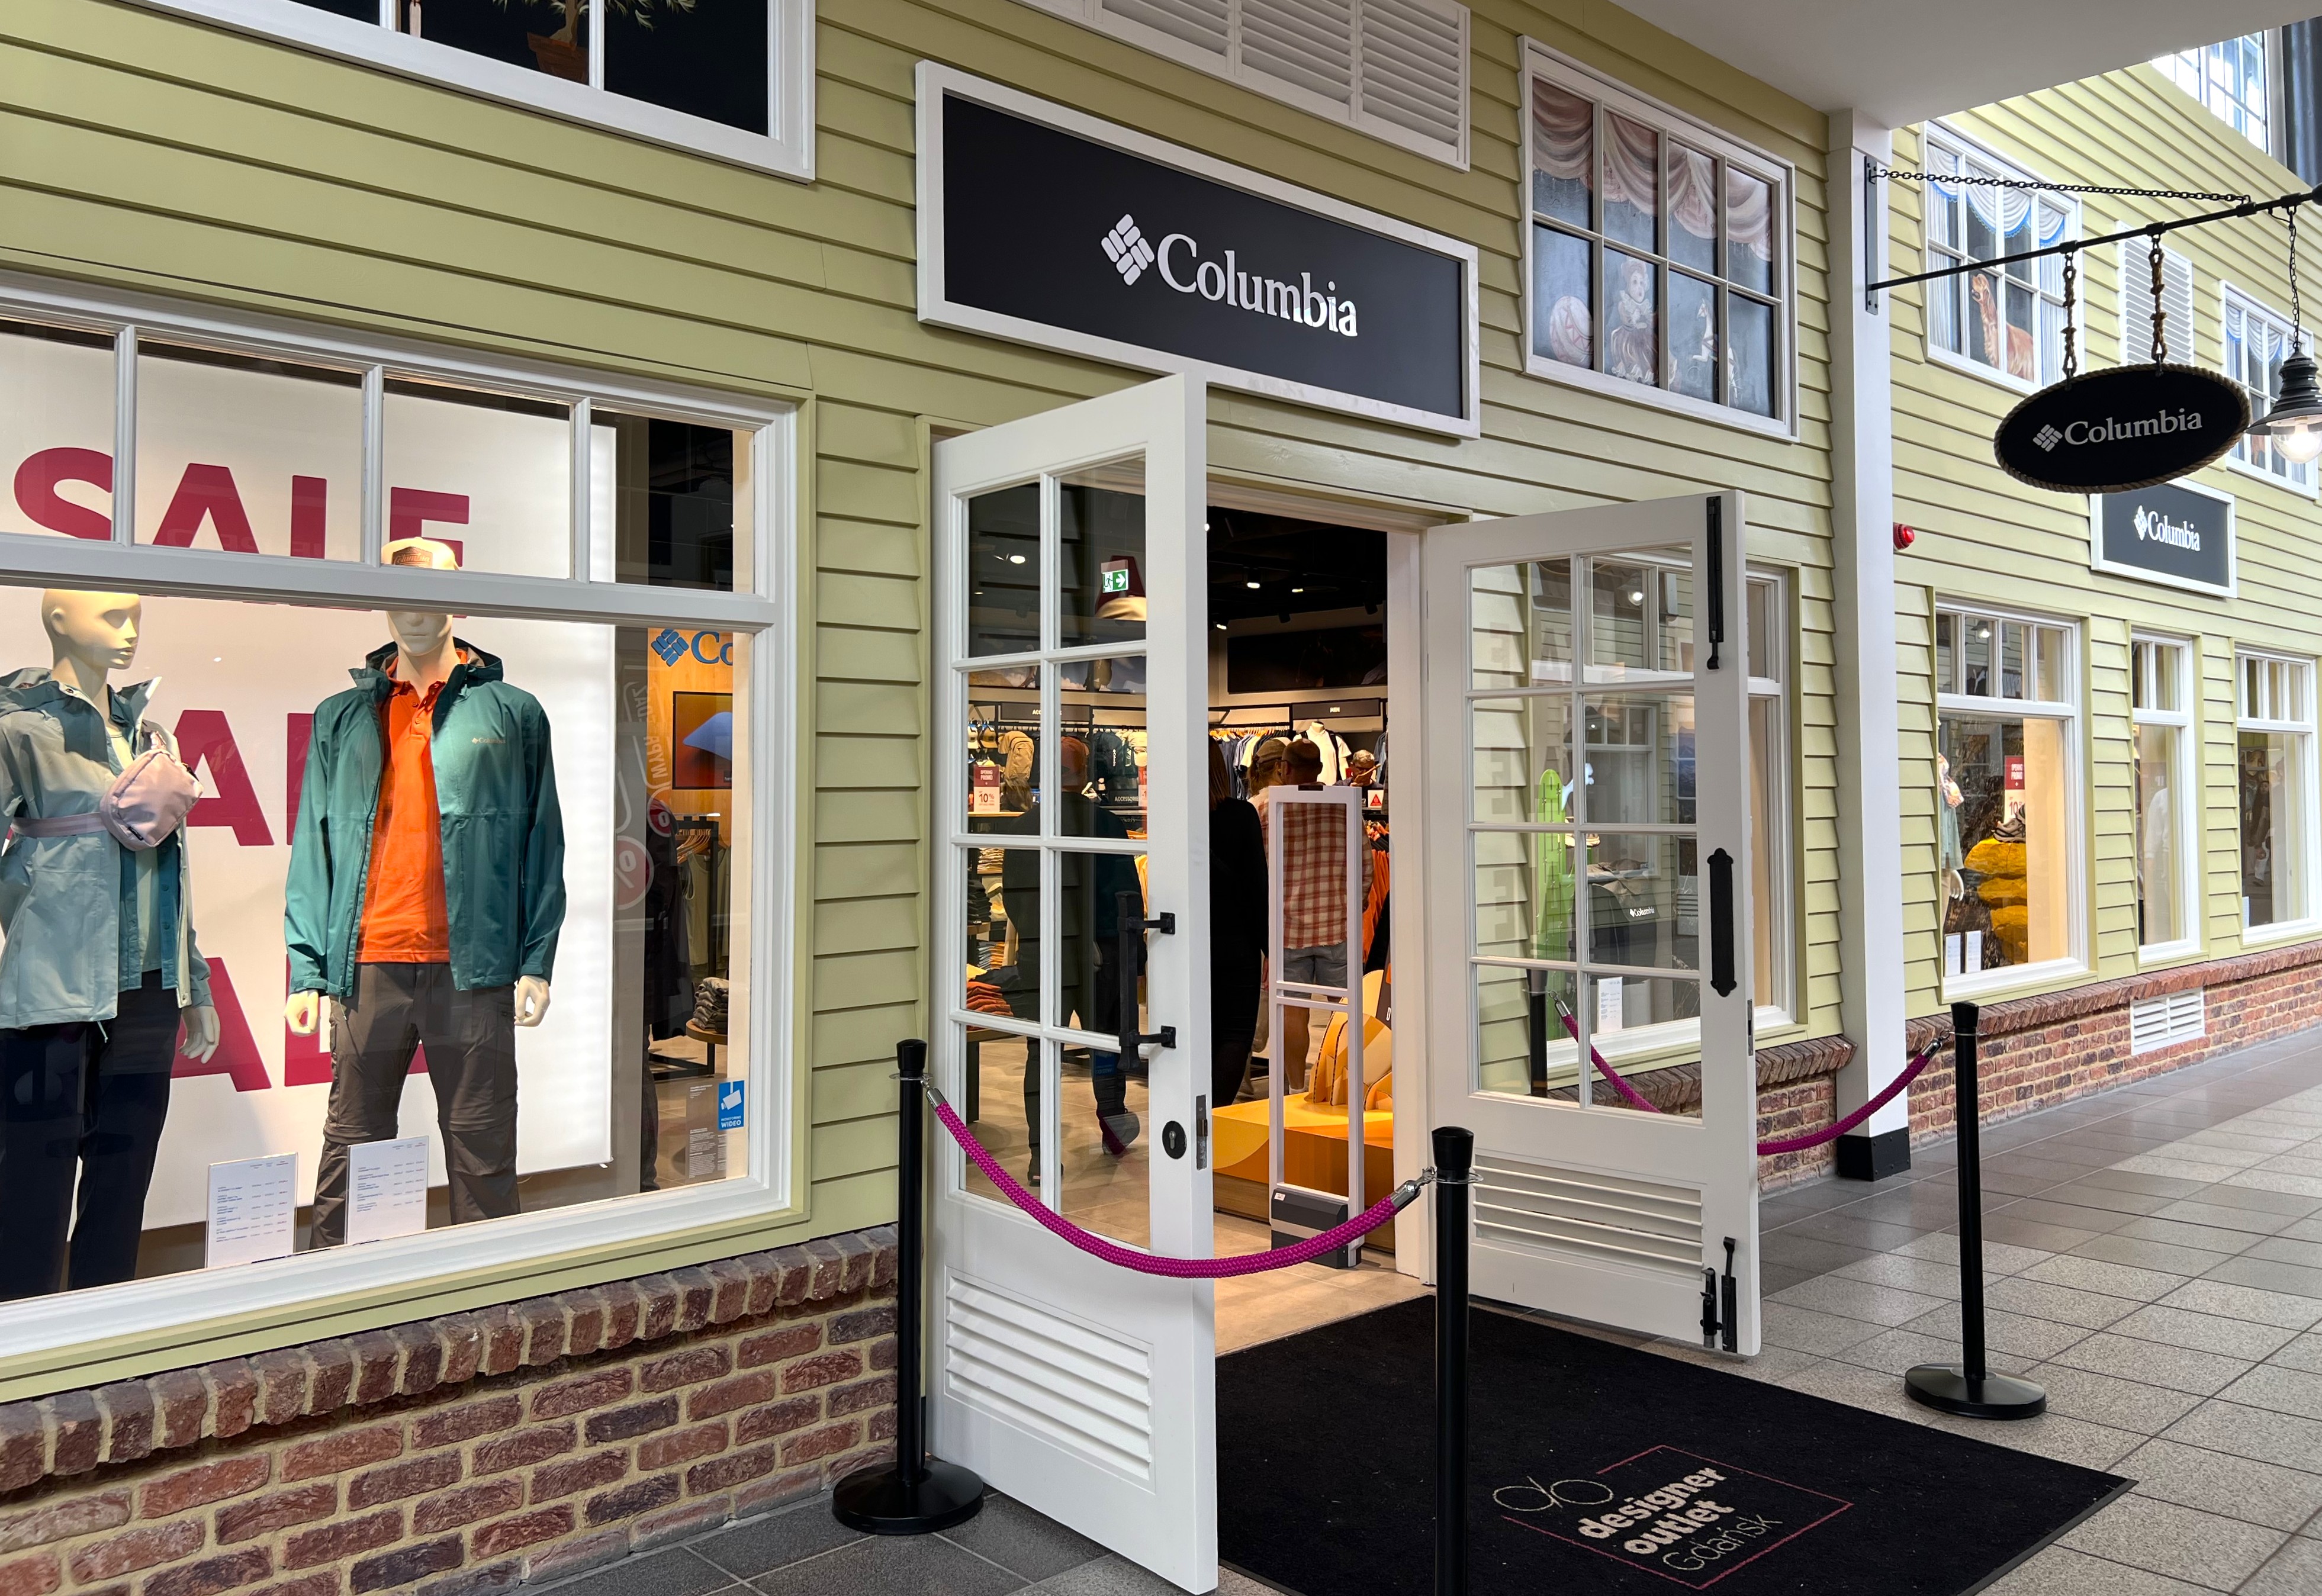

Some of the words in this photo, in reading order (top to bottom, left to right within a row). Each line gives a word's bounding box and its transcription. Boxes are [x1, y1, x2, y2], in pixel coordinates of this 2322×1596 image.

[1157, 233, 1358, 337] Columbia
[2064, 408, 2202, 445] Columbia
[2148, 511, 2201, 551] Columbia
[721, 1119, 741, 1128] WIDEO
[1578, 1467, 1727, 1539] designer
[1623, 1499, 1735, 1555] outlet
[1662, 1514, 1783, 1571] Gdańsk
